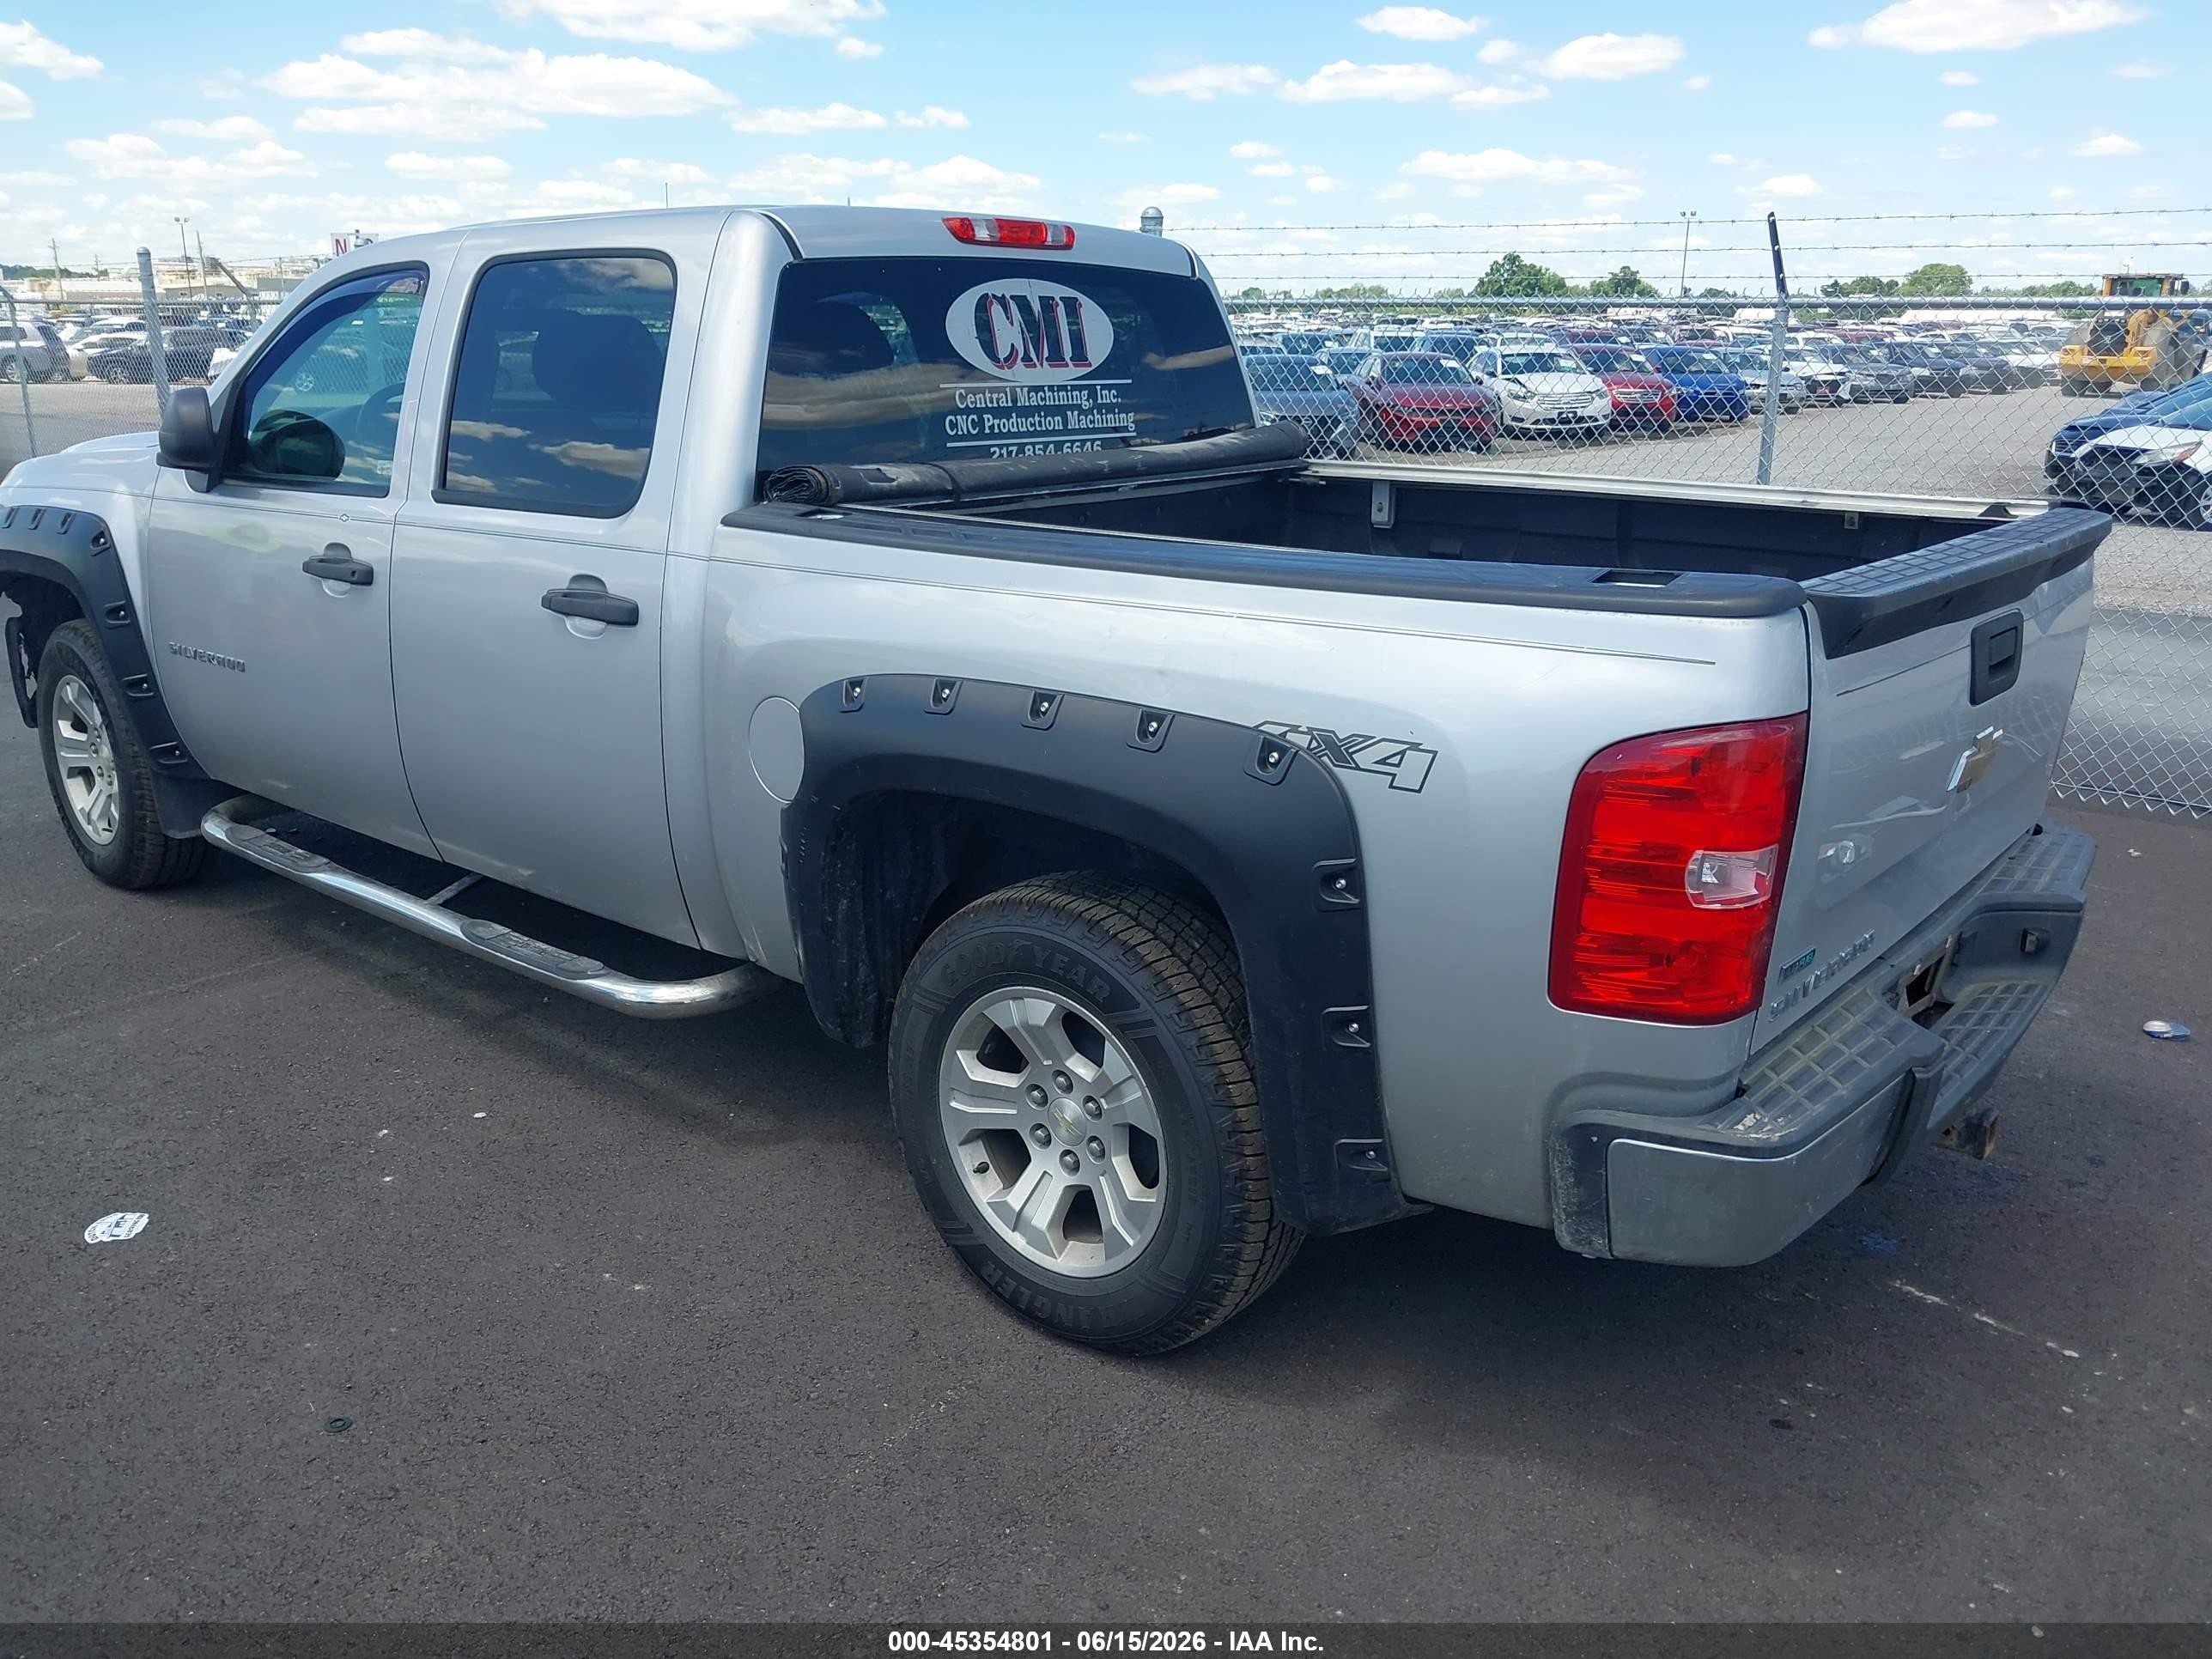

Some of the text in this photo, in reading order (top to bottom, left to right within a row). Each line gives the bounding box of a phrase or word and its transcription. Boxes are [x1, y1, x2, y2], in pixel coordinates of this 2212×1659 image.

[974, 292, 1092, 370] CMI
[955, 386, 1121, 410] Central Machining, Inc.
[945, 409, 1135, 435] CNC Production Machining
